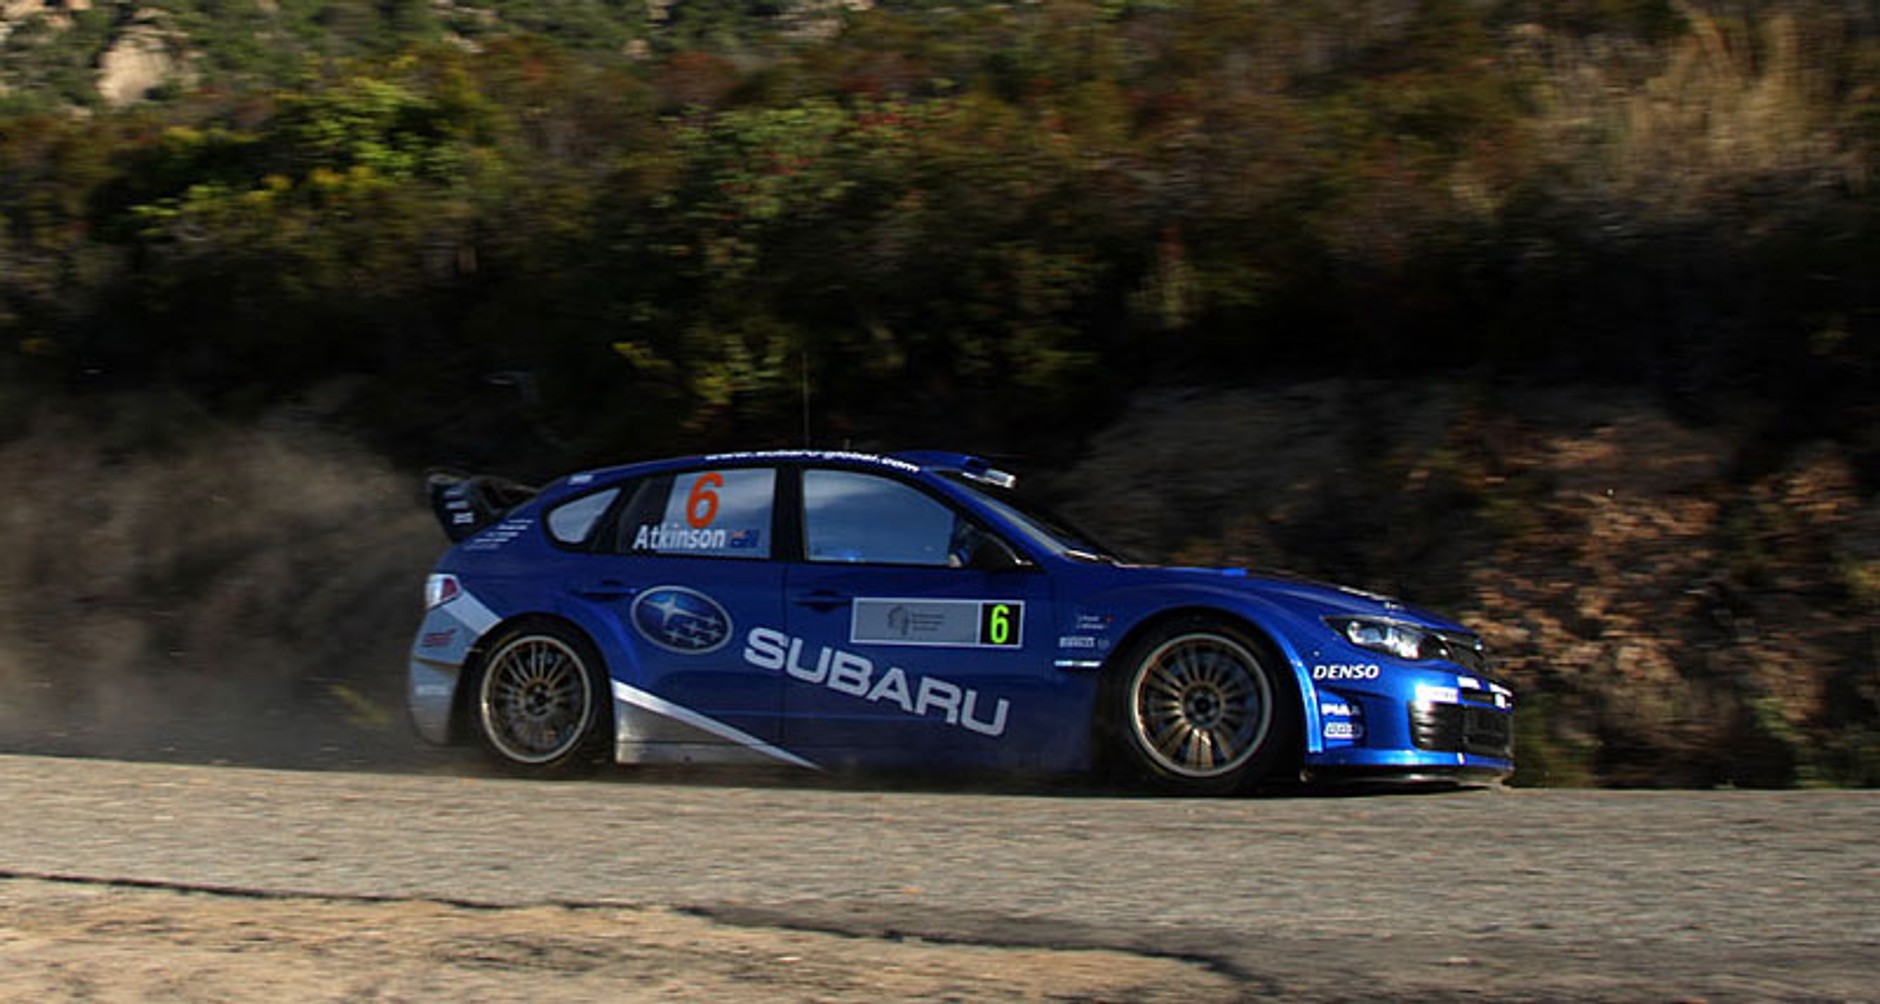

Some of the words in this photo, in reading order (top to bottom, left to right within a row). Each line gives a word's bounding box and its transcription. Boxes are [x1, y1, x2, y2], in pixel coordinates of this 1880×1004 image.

[686, 471, 724, 529] 6
[632, 522, 726, 549] Atkinson
[989, 603, 1010, 644] 6
[744, 626, 1010, 737] SUBARU
[1313, 664, 1379, 679] DENSO
